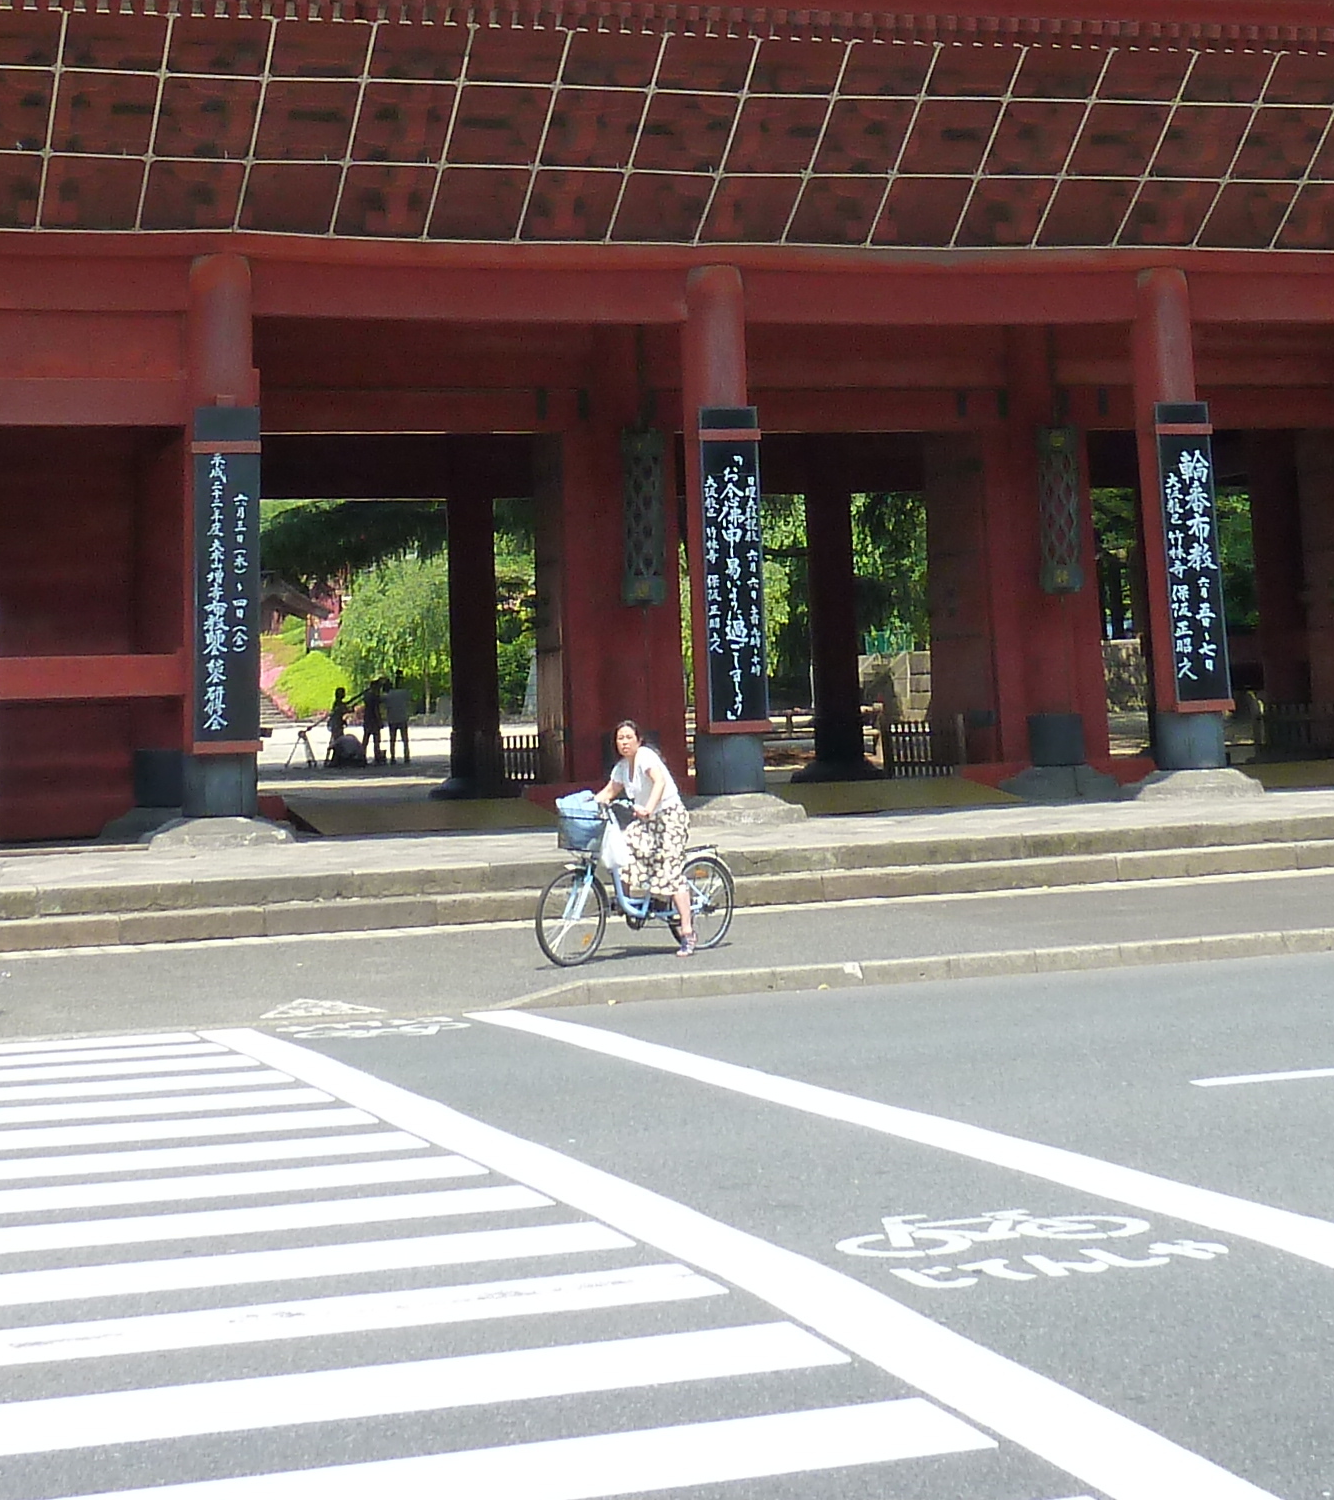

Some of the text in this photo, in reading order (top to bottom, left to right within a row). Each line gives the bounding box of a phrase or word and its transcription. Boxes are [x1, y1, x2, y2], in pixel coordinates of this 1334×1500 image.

[889, 1239, 1229, 1288] じてんしゃ
